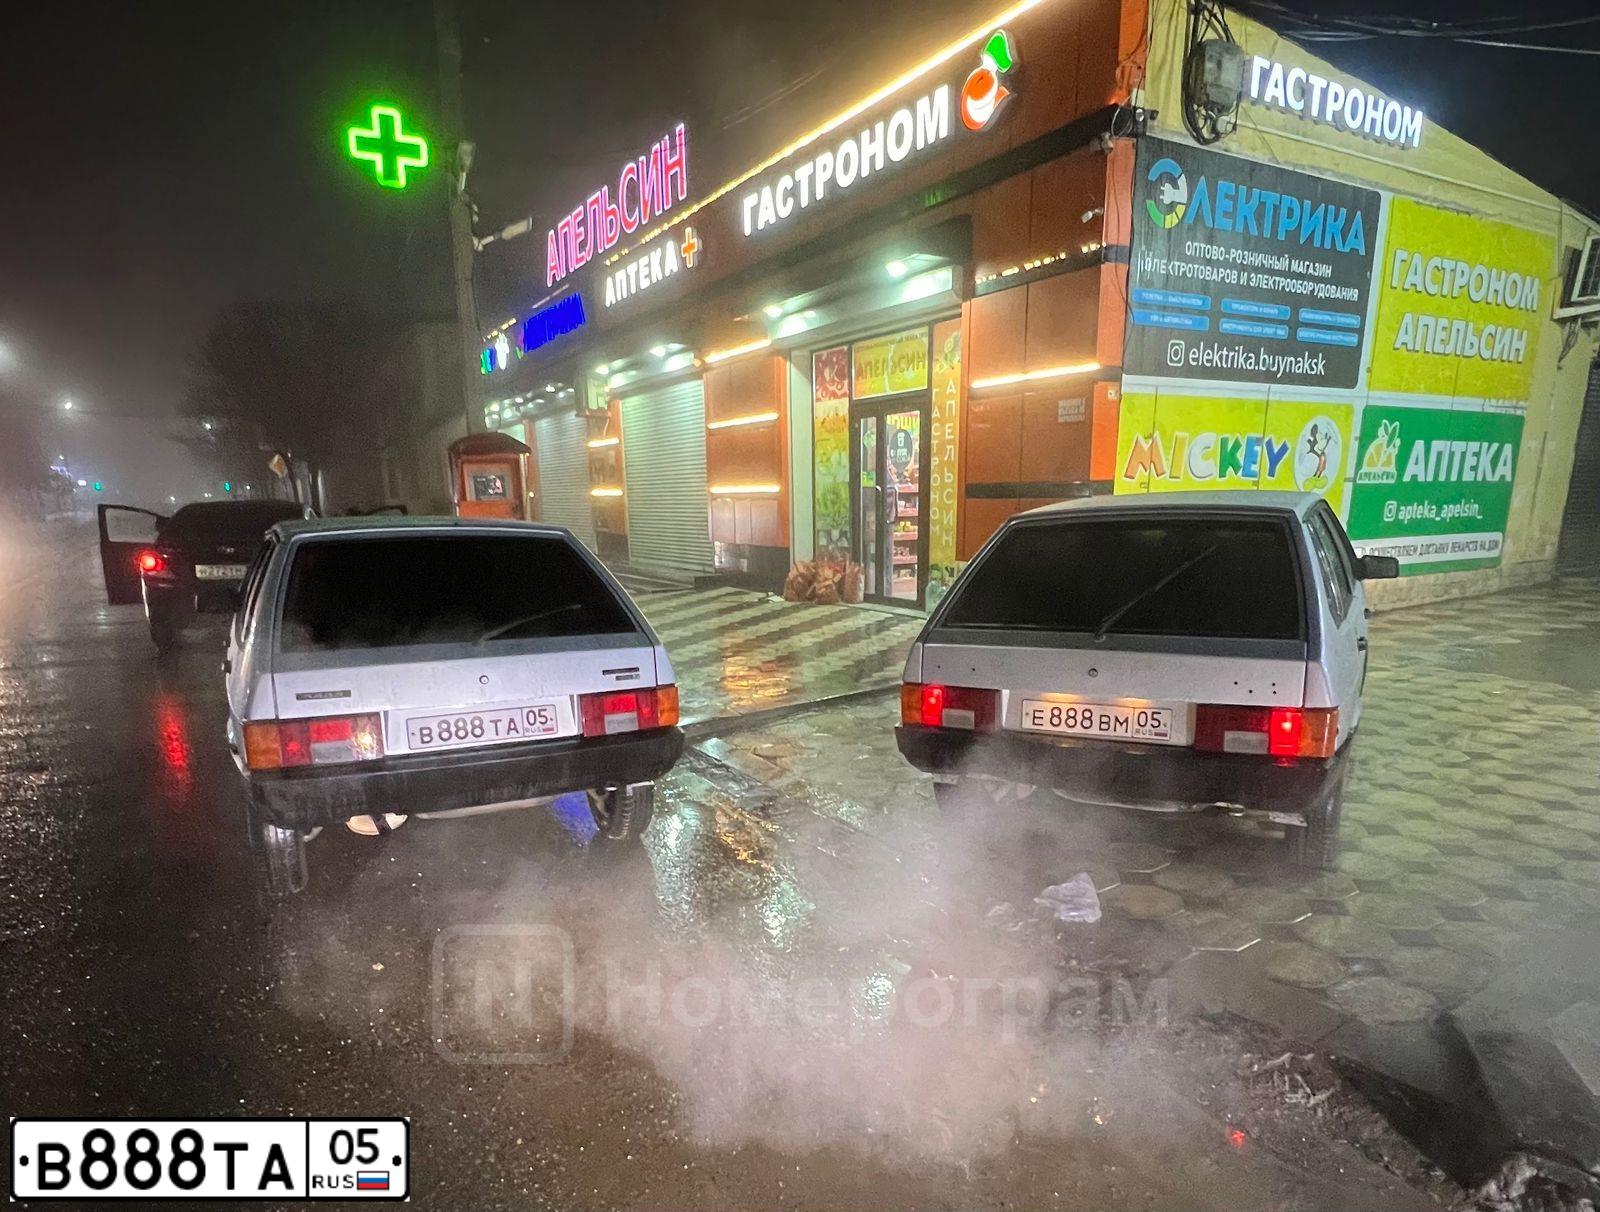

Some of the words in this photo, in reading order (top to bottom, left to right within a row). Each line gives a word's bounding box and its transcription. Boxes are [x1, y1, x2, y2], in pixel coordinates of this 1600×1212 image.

[1250, 55, 1423, 147] ГАСТРОНОМ
[743, 84, 949, 237] ГАСТРОНОМ
[546, 122, 687, 288] АПЕЛЬСИН
[605, 239, 678, 307] АПТЕКА
[1185, 240, 1290, 272] ОПТОВО-РОЗНИЧНЫЙ
[1290, 258, 1332, 278] МАГАЗИН
[1391, 248, 1540, 313] ГАСТРОНОМ
[1240, 271, 1248, 286] И
[1249, 272, 1359, 301] ЭЛЕКТРООБОРУДОВАНИЯ
[1188, 342, 1326, 378] elektrika.buynaksk
[1394, 312, 1528, 364] АПЕЛЬСИН
[930, 388, 941, 535] ГАСТРОНОМ
[943, 379, 957, 546] АПЕЛЬСИН
[1123, 431, 1291, 480] MICKEY
[1402, 440, 1513, 482] АПТЕКА
[1398, 499, 1483, 524] apteka_apelsin_
[419, 715, 519, 744] В888ТА
[526, 708, 549, 726] 05
[1032, 706, 1129, 733] Е888ВМ
[1137, 711, 1162, 729] 05
